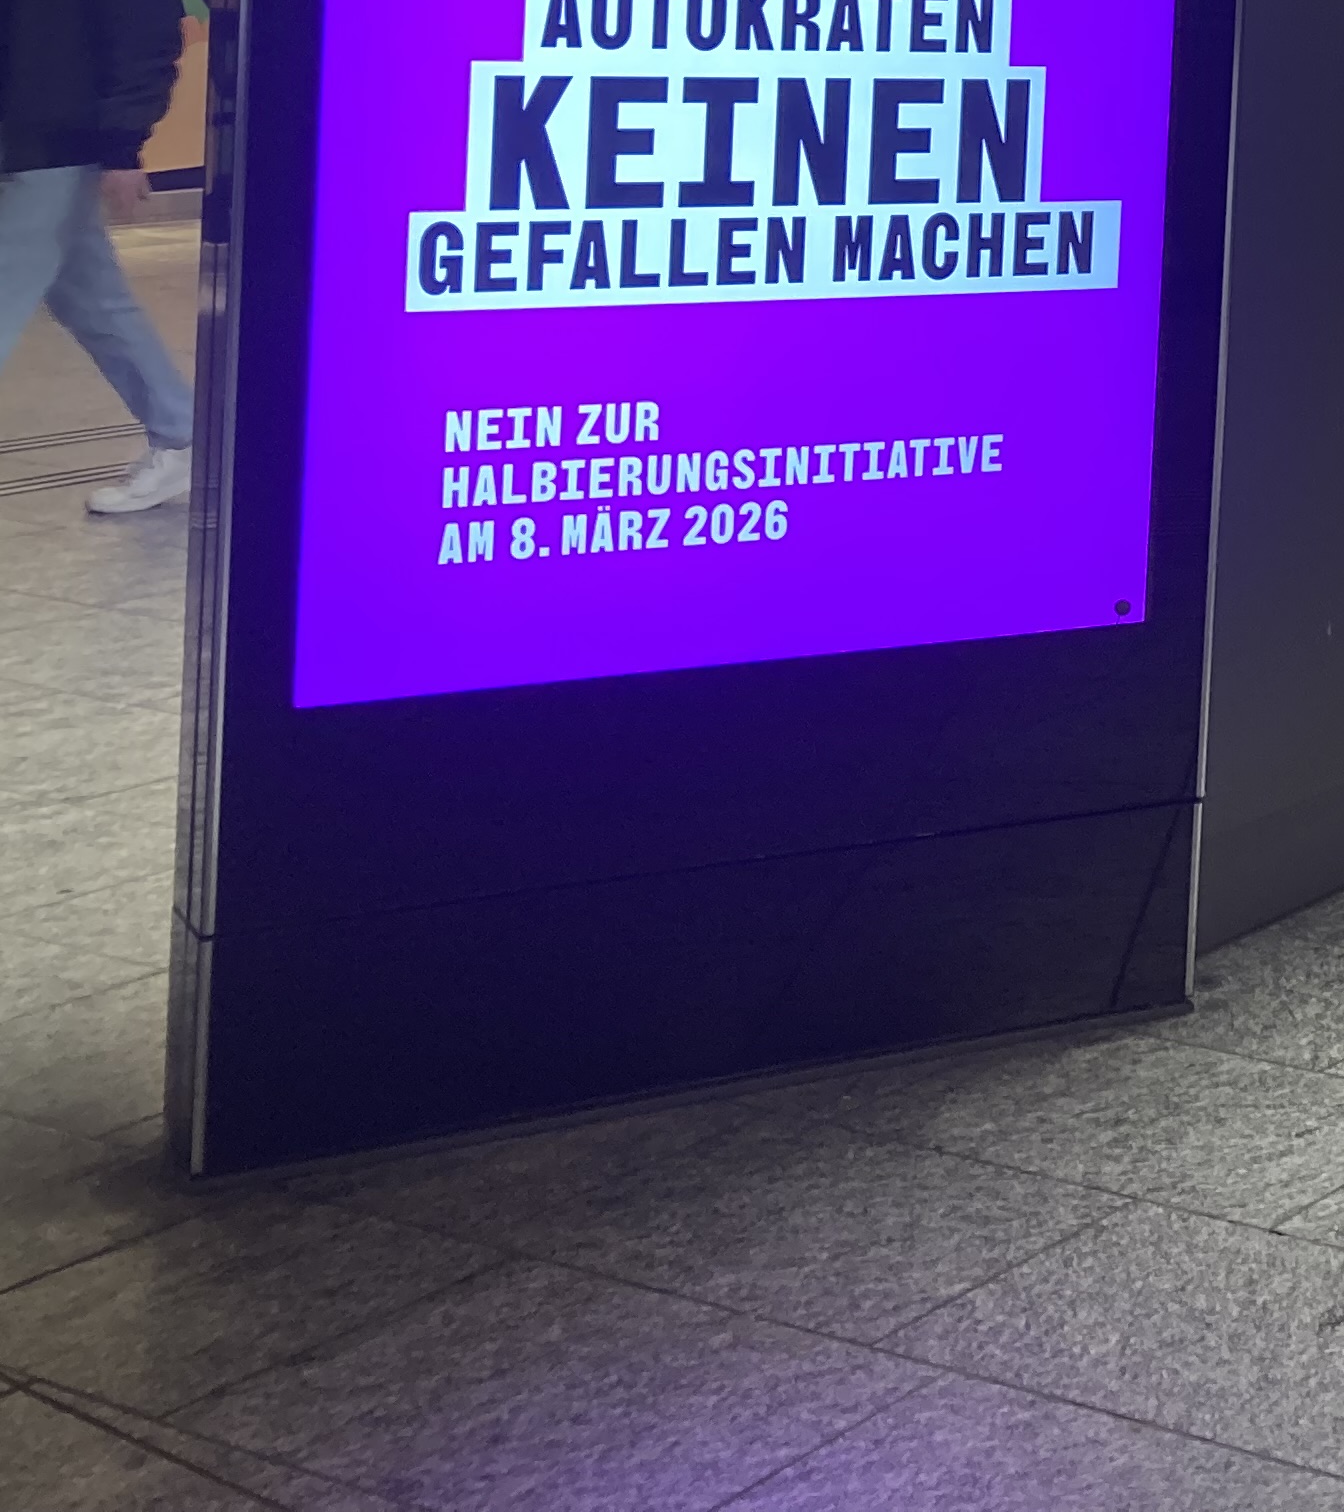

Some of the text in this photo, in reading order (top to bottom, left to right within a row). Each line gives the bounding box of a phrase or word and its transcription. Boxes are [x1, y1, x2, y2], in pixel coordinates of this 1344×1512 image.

[489, 75, 1032, 211] KEINEN
[419, 210, 1095, 295] GEFALLEN MACHEN
[444, 400, 661, 452] NEIN ZUR
[441, 434, 1004, 509] HALBIERUNGSINITIATIVE
[438, 500, 789, 565] AM 8. MÄRZ 2026
